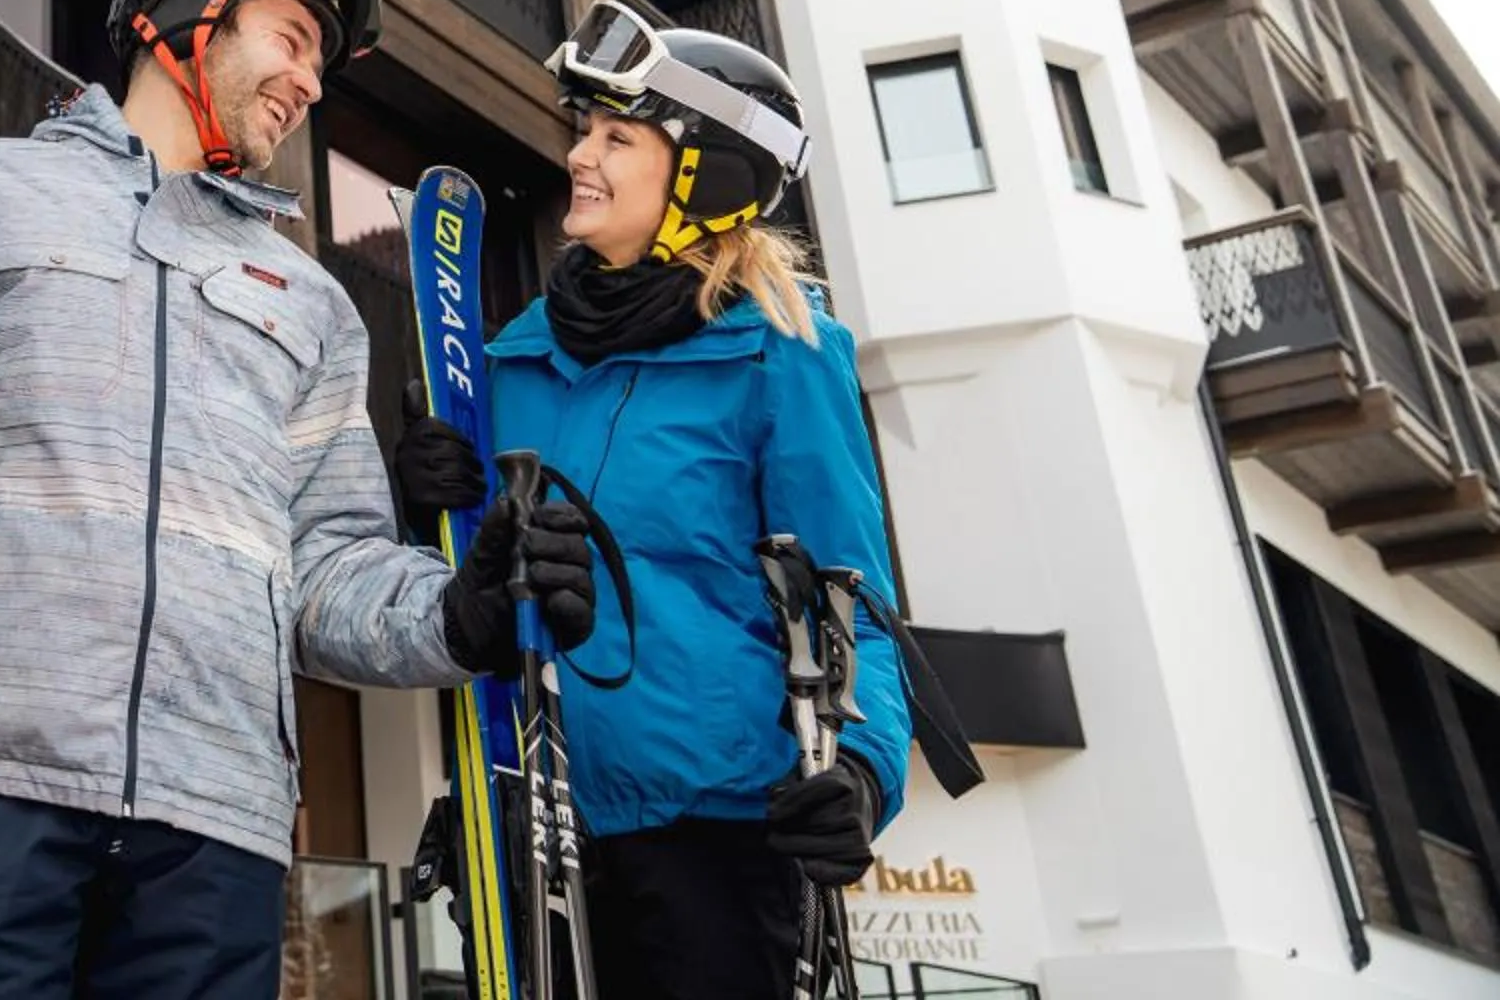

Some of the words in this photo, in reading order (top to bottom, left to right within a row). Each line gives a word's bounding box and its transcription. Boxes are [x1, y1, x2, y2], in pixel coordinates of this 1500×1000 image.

[531, 770, 548, 866] LEKI
[552, 779, 580, 869] LEKI
[850, 911, 984, 935] IZZERIA
[851, 937, 988, 961] ISTORANTE
